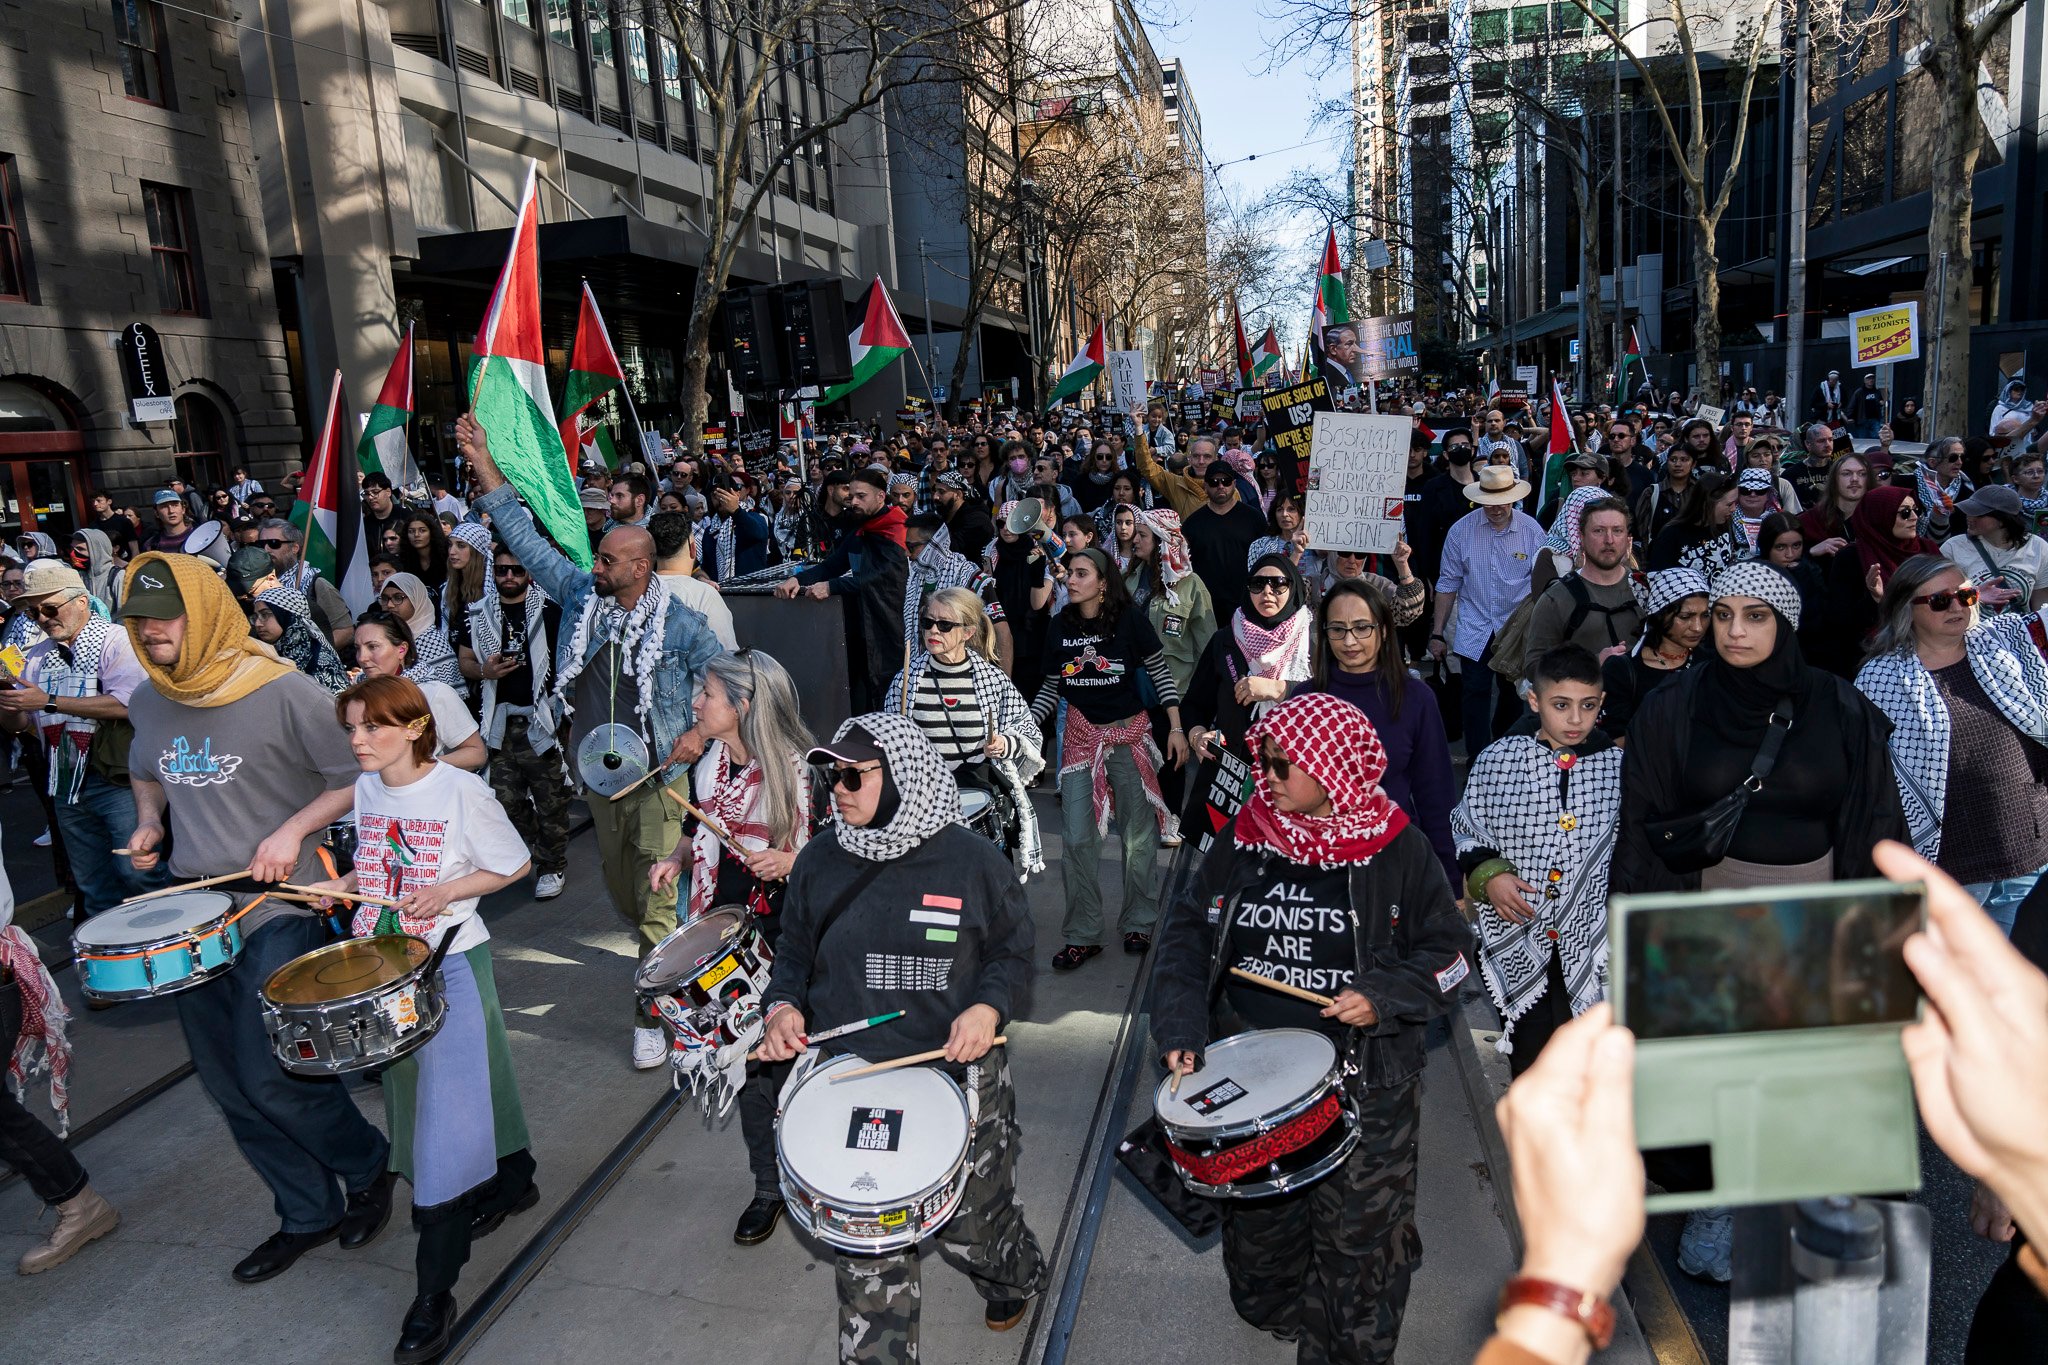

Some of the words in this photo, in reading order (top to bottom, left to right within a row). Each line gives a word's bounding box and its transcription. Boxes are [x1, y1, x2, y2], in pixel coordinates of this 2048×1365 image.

[1873, 314, 1893, 322] FUCK
[1873, 318, 1910, 330] ZIONISTS
[1380, 324, 1391, 337] THE
[1393, 320, 1412, 336] MOST
[133, 322, 156, 396] COFFEX
[1118, 357, 1132, 369] PA
[1387, 359, 1396, 370] THE
[1397, 356, 1418, 368] WORLD
[1120, 370, 1132, 382] LE
[1121, 383, 1133, 395] ST
[1263, 392, 1293, 412] YOU'RE
[1292, 385, 1314, 404] SICK
[1314, 381, 1325, 398] OF
[1288, 403, 1312, 426] US?
[1275, 428, 1303, 448] WE'RE
[1303, 425, 1313, 442] SI
[1319, 417, 1398, 450] Bosnian
[1316, 448, 1404, 474] GENOCIDE
[1309, 491, 1349, 515] STAND
[1354, 495, 1384, 518] WITH
[1063, 635, 1103, 646] BLACKFUL
[1066, 676, 1120, 686] PALESTINIANS
[624, 741, 638, 757] FROM
[1222, 752, 1248, 780] DEA
[1215, 768, 1242, 800] DEA
[1208, 784, 1225, 806] TO
[406, 821, 443, 832] LIBERATION
[413, 852, 438, 862] ATION
[1265, 882, 1314, 901] ALL
[1237, 903, 1345, 933] ZIONISTS
[1265, 935, 1312, 961] ARE
[869, 1109, 885, 1118] IDF
[862, 1122, 876, 1131] THE
[859, 1130, 890, 1140] DEATH
[857, 1138, 888, 1150] DEATH
